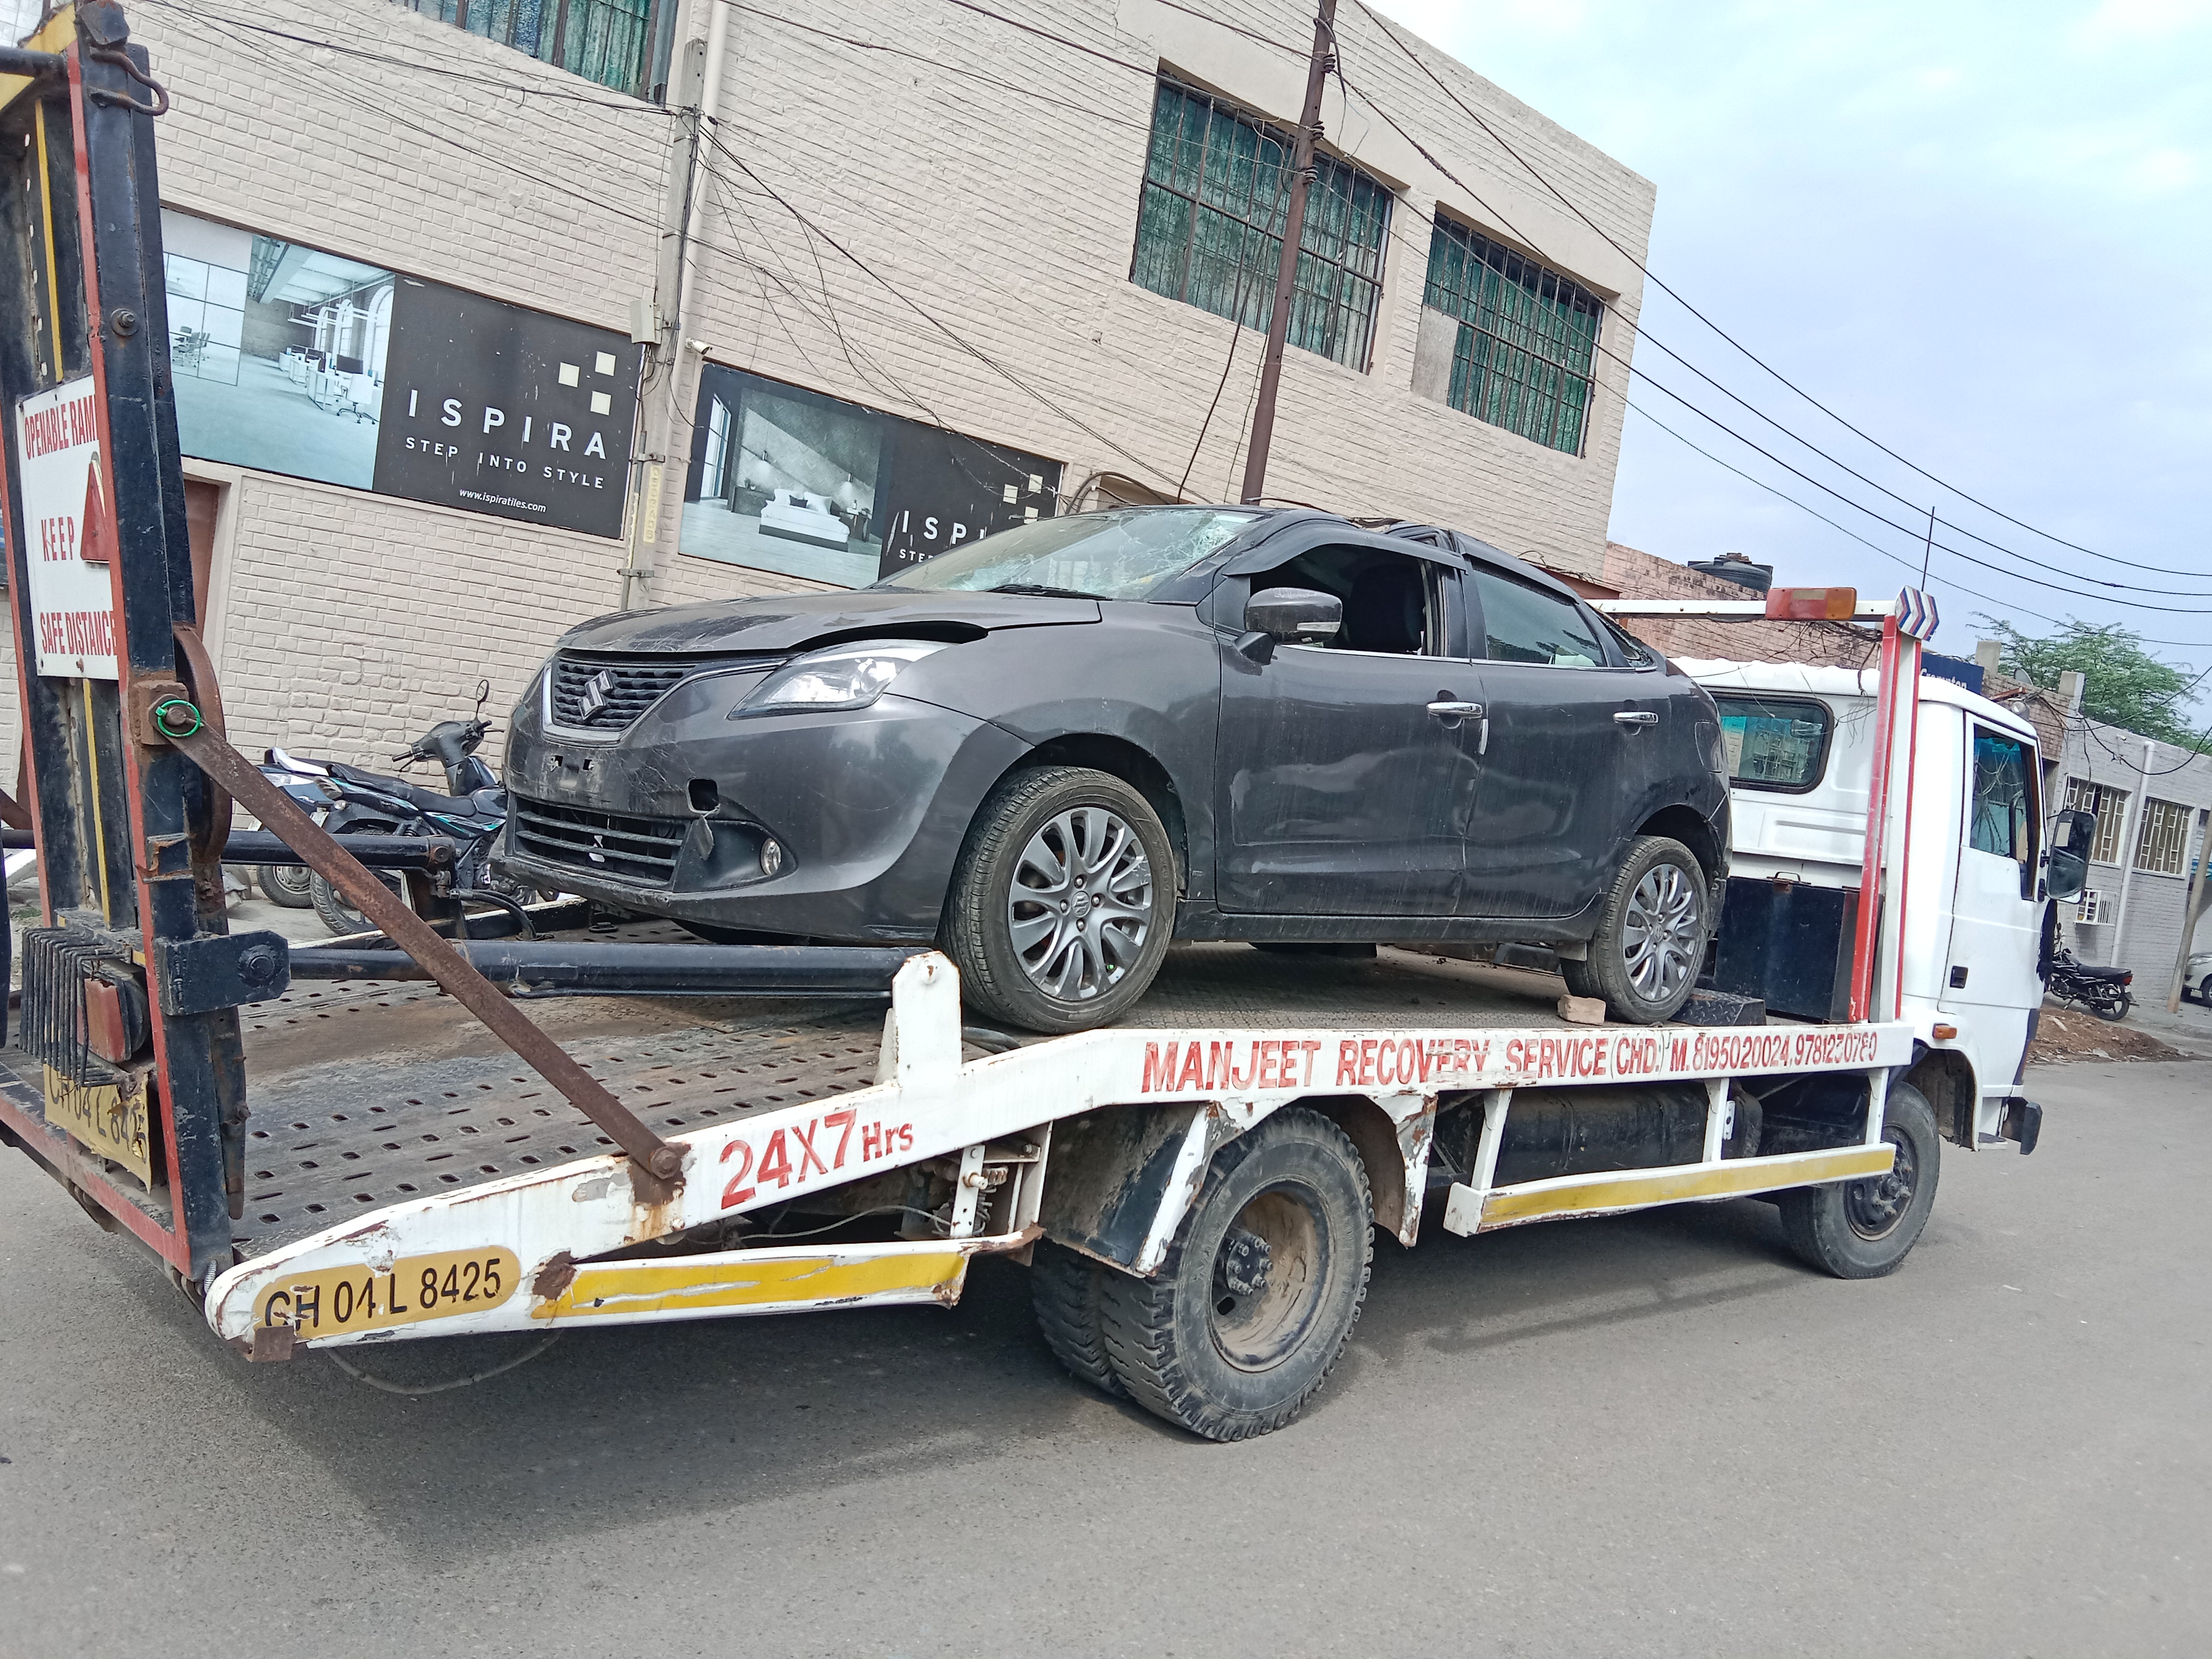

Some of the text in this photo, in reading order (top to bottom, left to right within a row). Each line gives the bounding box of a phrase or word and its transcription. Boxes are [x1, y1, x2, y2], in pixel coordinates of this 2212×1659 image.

[25, 394, 97, 460] OPENABLE RAM
[408, 389, 607, 460] ISPIRA
[405, 437, 605, 489] STEP INTO STYLE
[459, 489, 547, 513] www.ispiratiles.com
[40, 516, 75, 562] KEEP
[40, 610, 117, 657] SAFE DISTANCE
[1141, 1040, 1322, 1093] MANJEET
[1336, 1038, 1490, 1086] RECOVERY
[1505, 1038, 1609, 1078] SERVICE
[719, 1109, 915, 1210] 24X7 Hrs
[265, 1285, 320, 1331] CH
[420, 1258, 501, 1309] 8425
